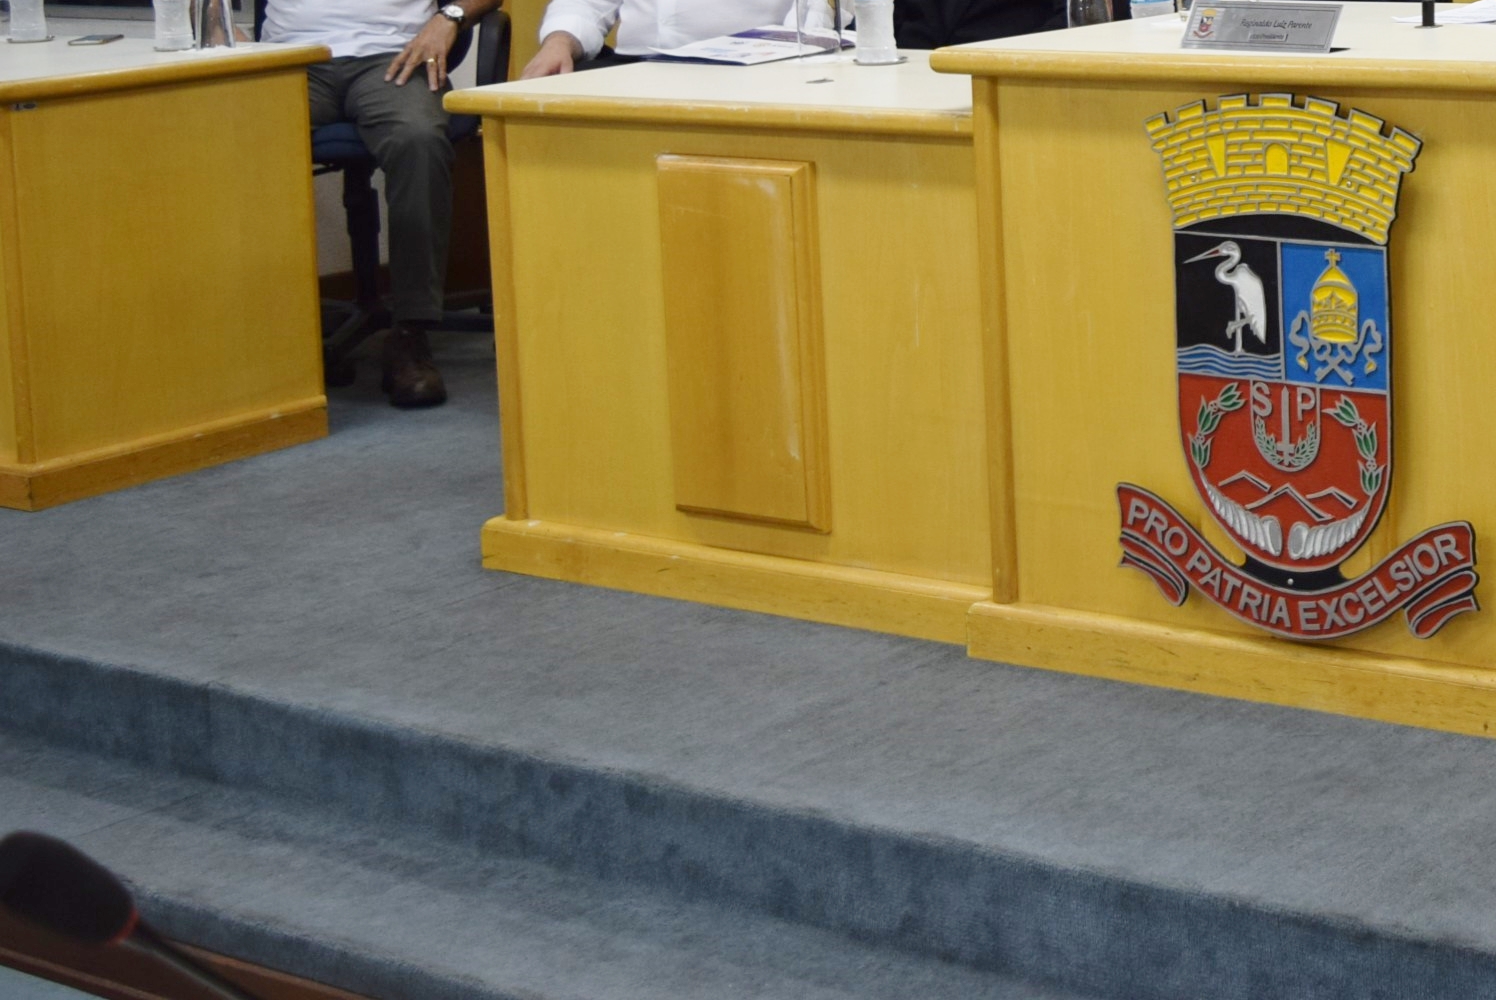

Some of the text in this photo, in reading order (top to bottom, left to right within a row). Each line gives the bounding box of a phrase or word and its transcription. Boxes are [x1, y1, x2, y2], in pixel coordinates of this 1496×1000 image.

[1127, 498, 1465, 631] PRO PATRIA EXCELSIOR
